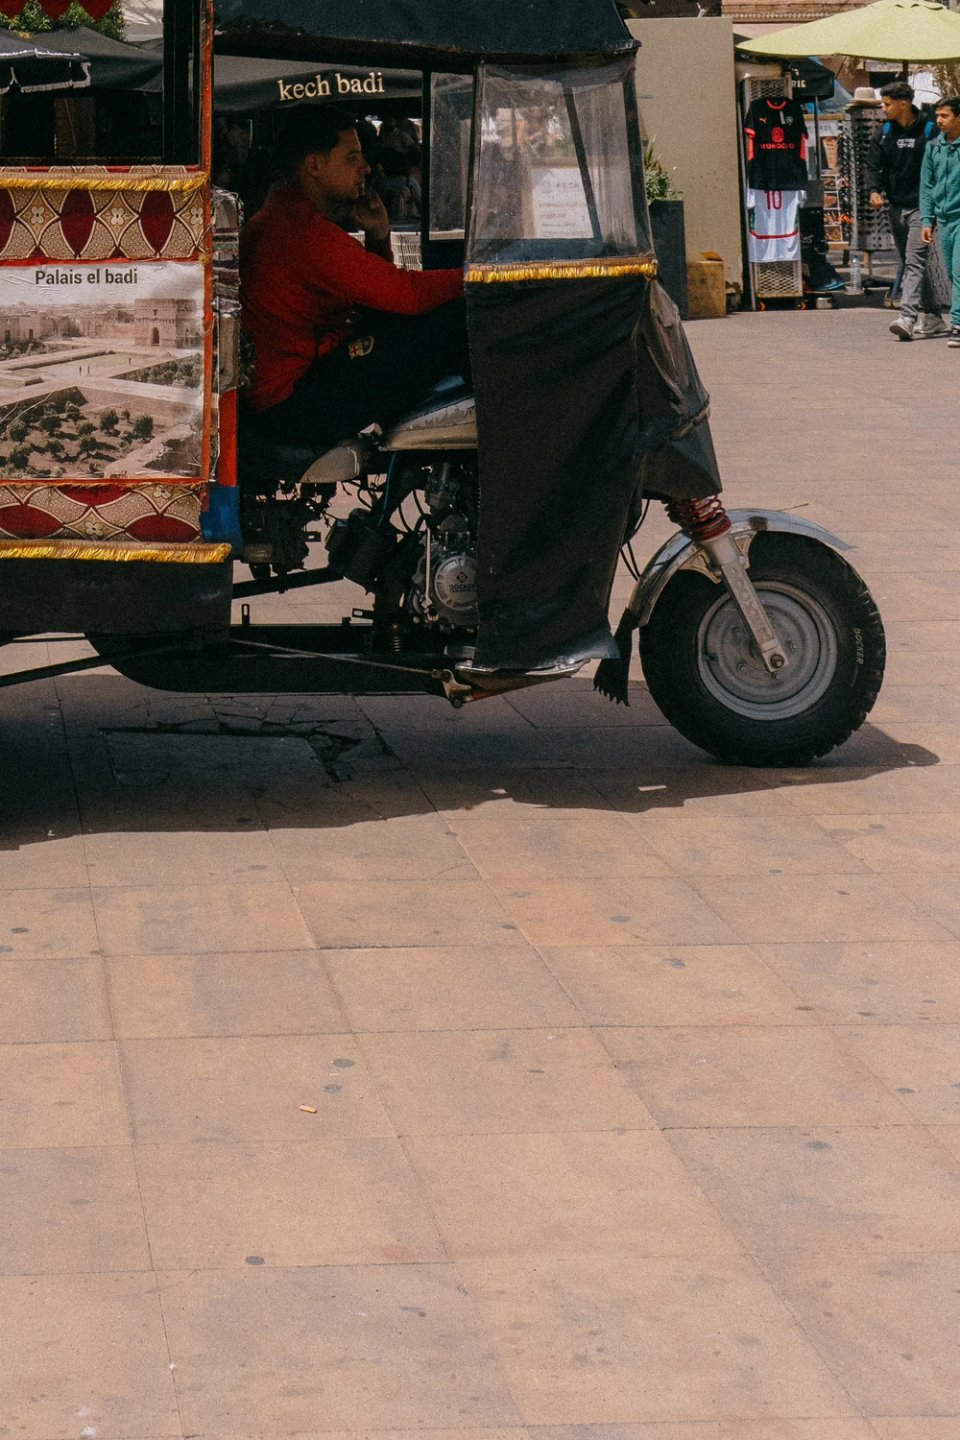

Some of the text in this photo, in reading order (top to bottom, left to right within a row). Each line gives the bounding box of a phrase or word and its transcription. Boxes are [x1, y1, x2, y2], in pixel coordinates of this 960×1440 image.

[277, 72, 385, 100] kech badi
[764, 190, 783, 210] 10
[35, 268, 138, 285] Palais el badi
[853, 628, 864, 665] DOCKER
